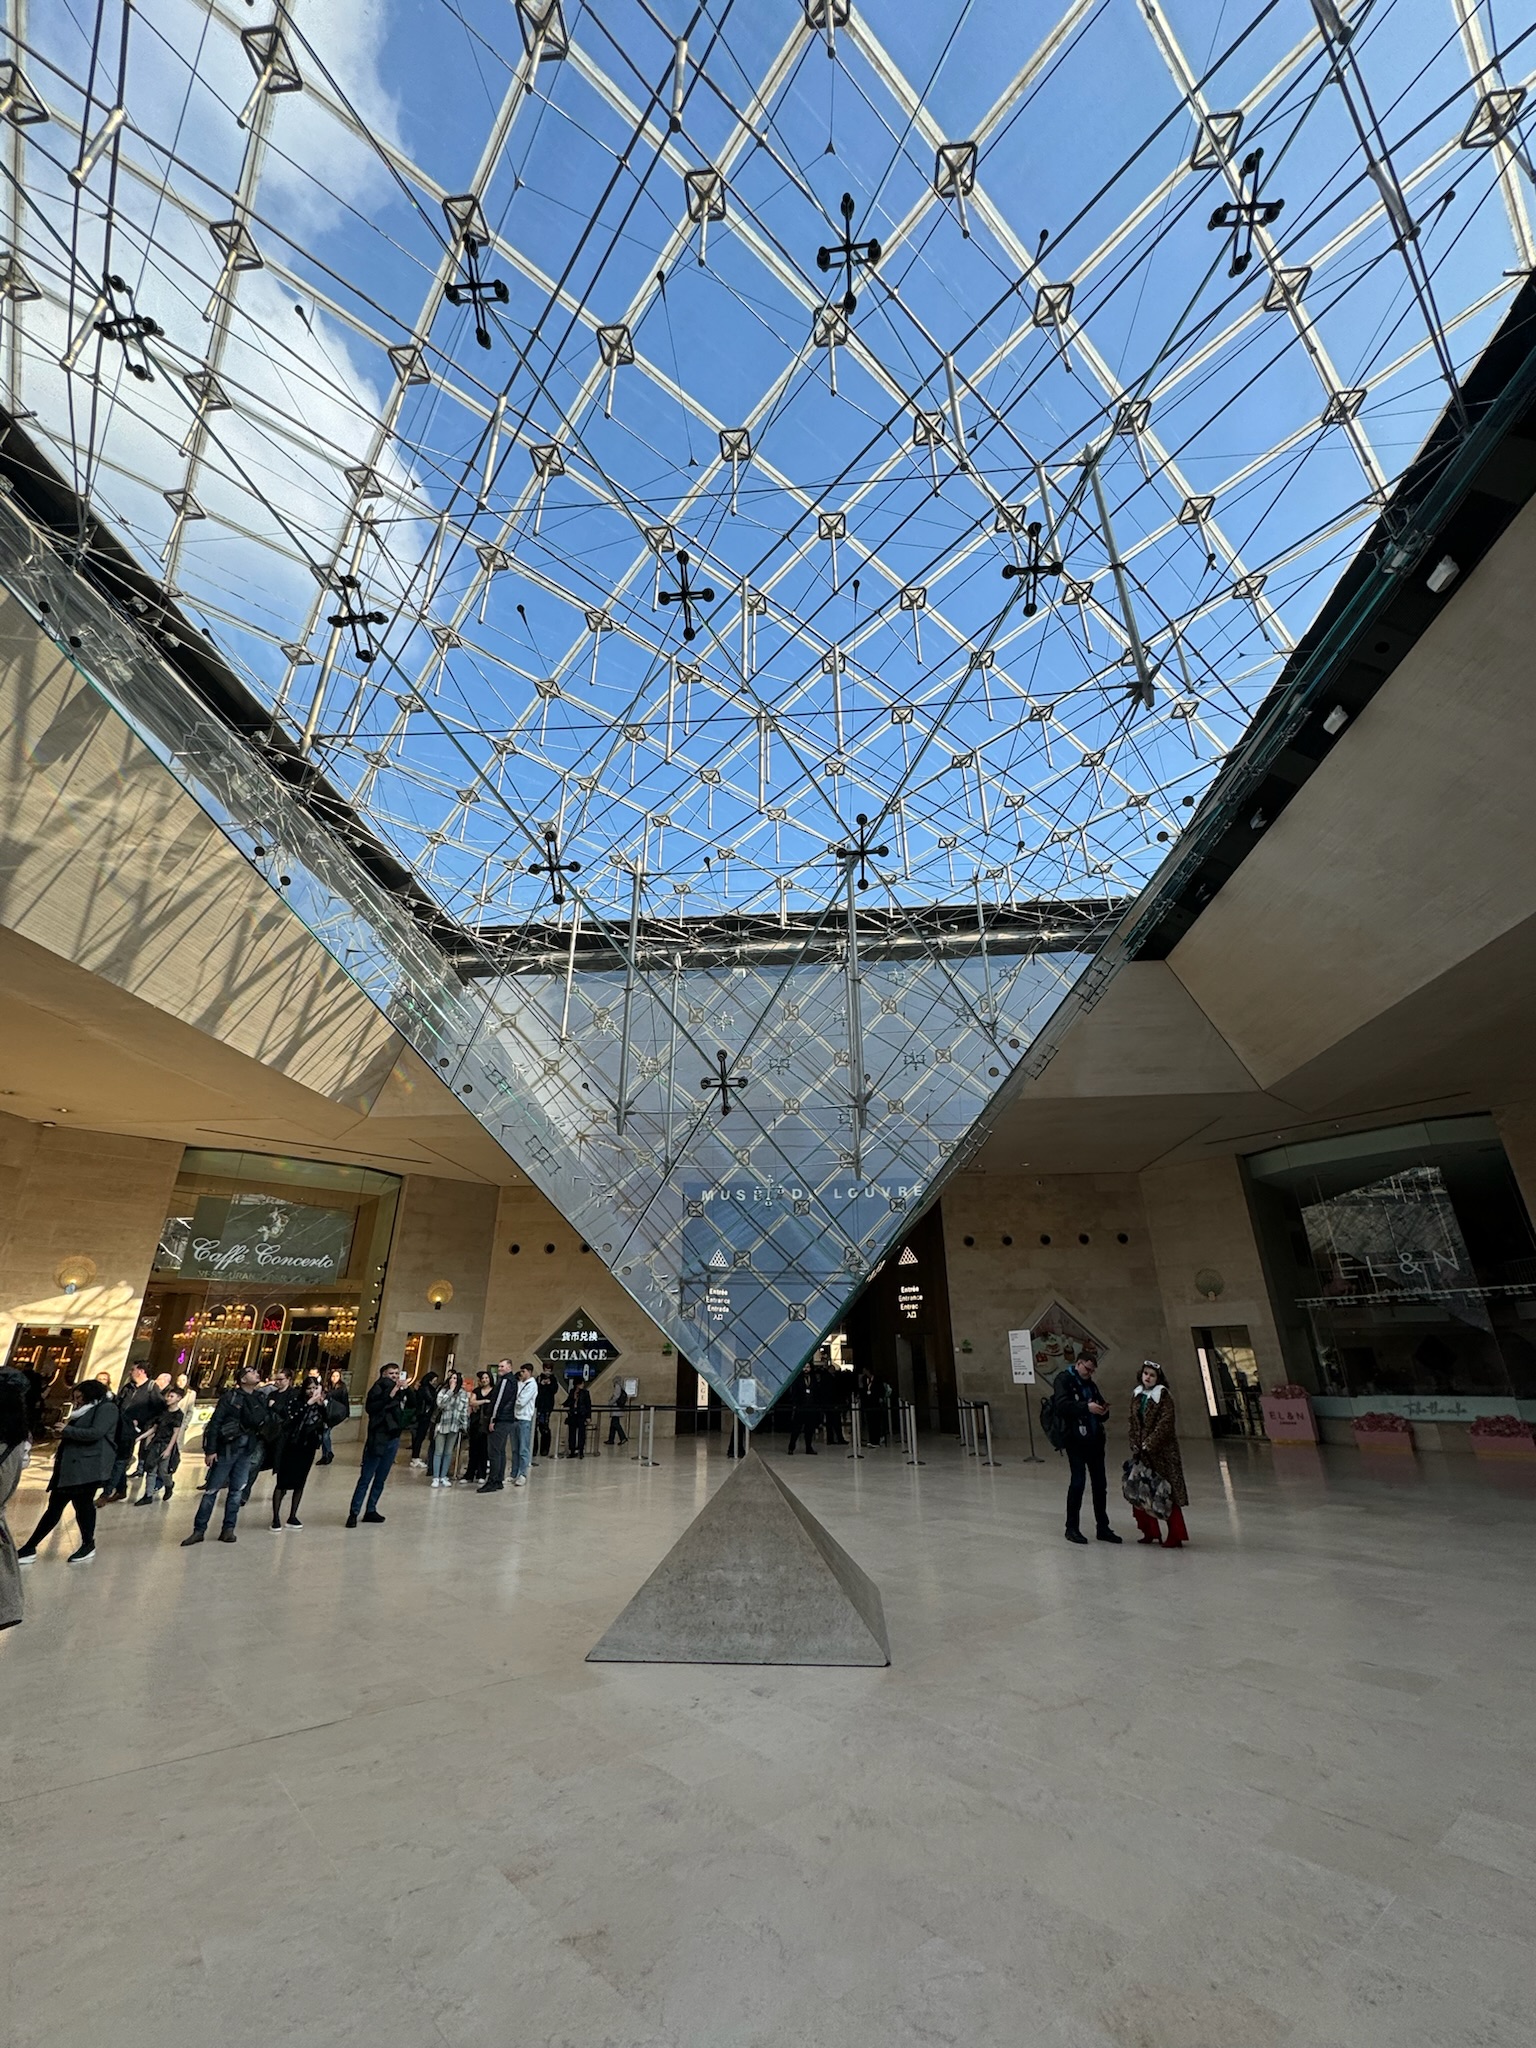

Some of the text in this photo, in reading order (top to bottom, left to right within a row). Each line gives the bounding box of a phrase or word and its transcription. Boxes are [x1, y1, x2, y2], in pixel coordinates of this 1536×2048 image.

[834, 1185, 923, 1199] LOUVRE
[192, 1237, 334, 1270] Caffé Concerto
[706, 1296, 730, 1304] Entrance
[561, 1331, 598, 1341] 货币兑换
[549, 1349, 608, 1361] CHANGE
